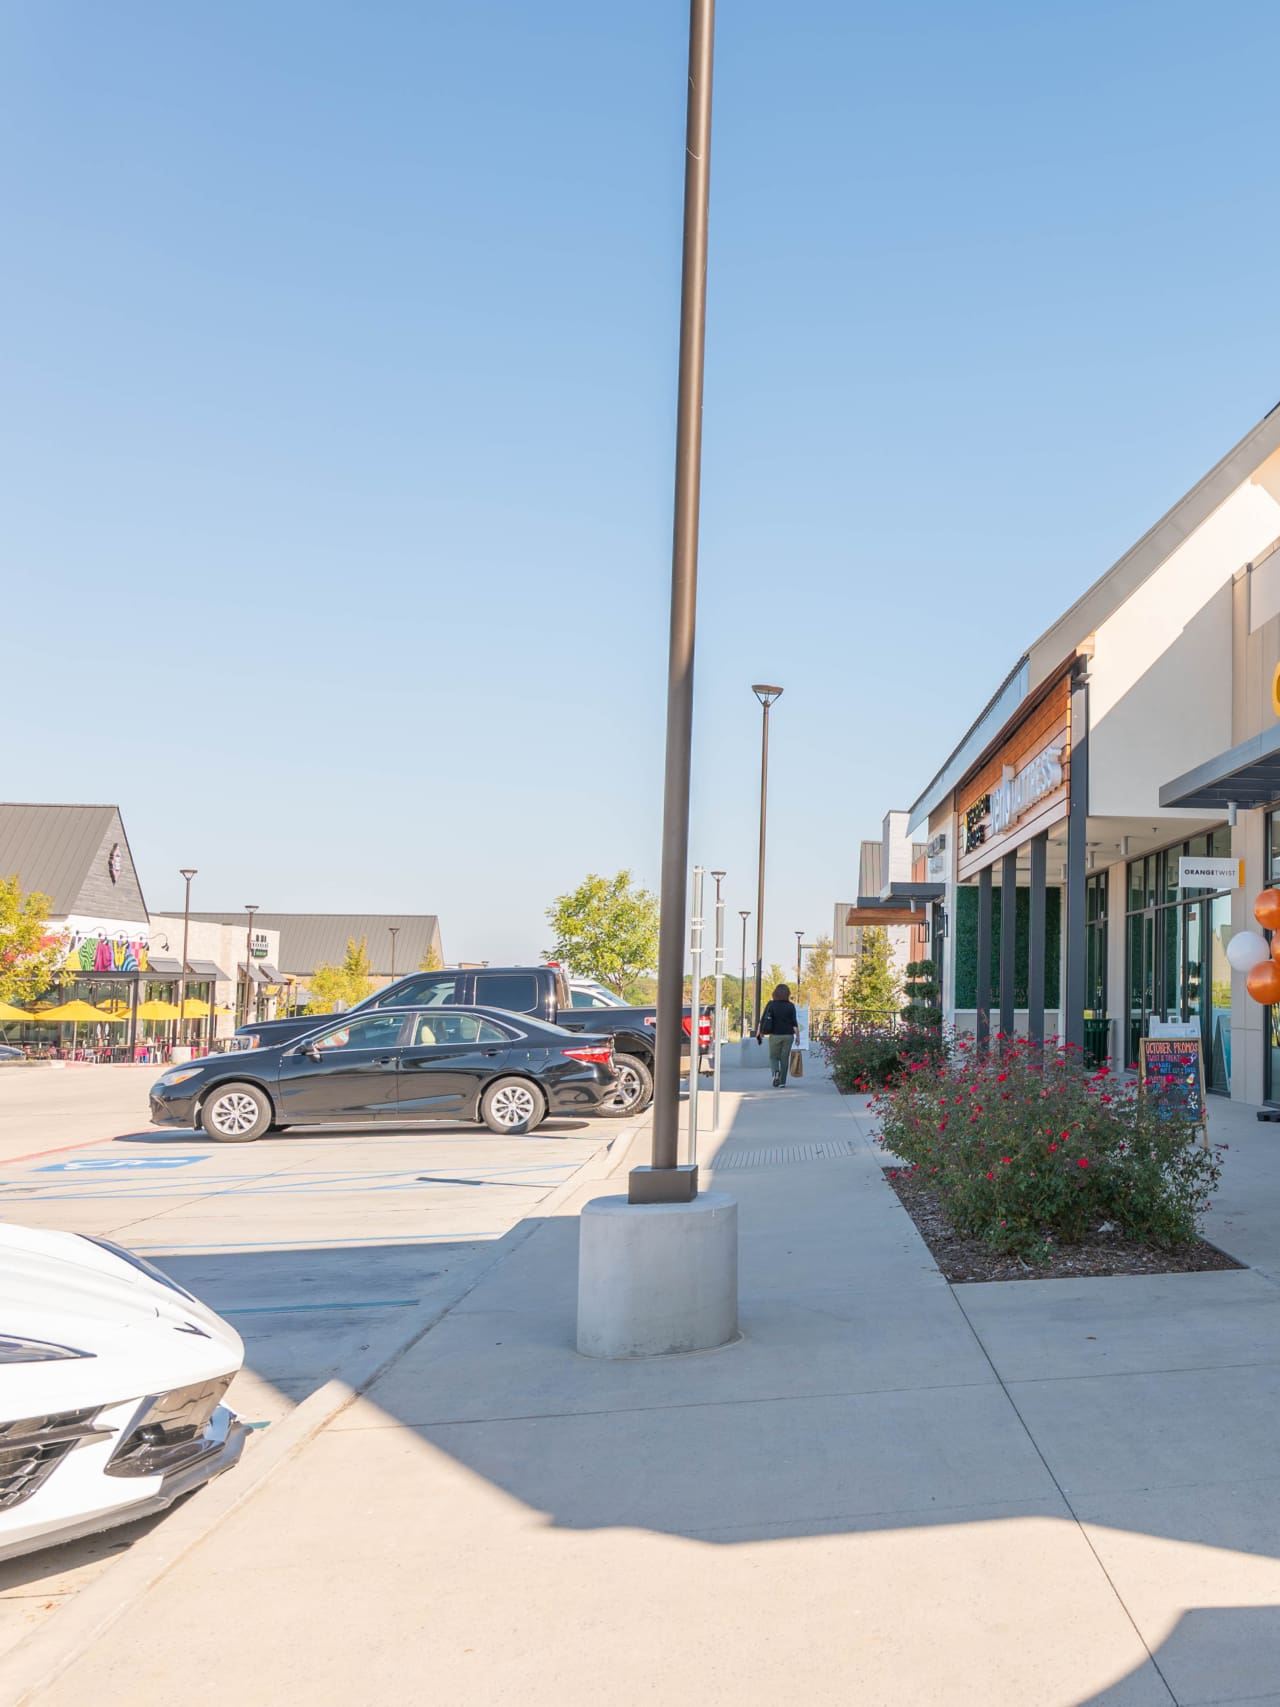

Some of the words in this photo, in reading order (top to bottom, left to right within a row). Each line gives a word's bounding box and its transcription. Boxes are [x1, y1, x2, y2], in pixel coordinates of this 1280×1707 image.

[1183, 869, 1236, 877] ORANGETWIST
[1145, 1042, 1172, 1054] OCTOBER
[1173, 1042, 1199, 1054] PROMOS
